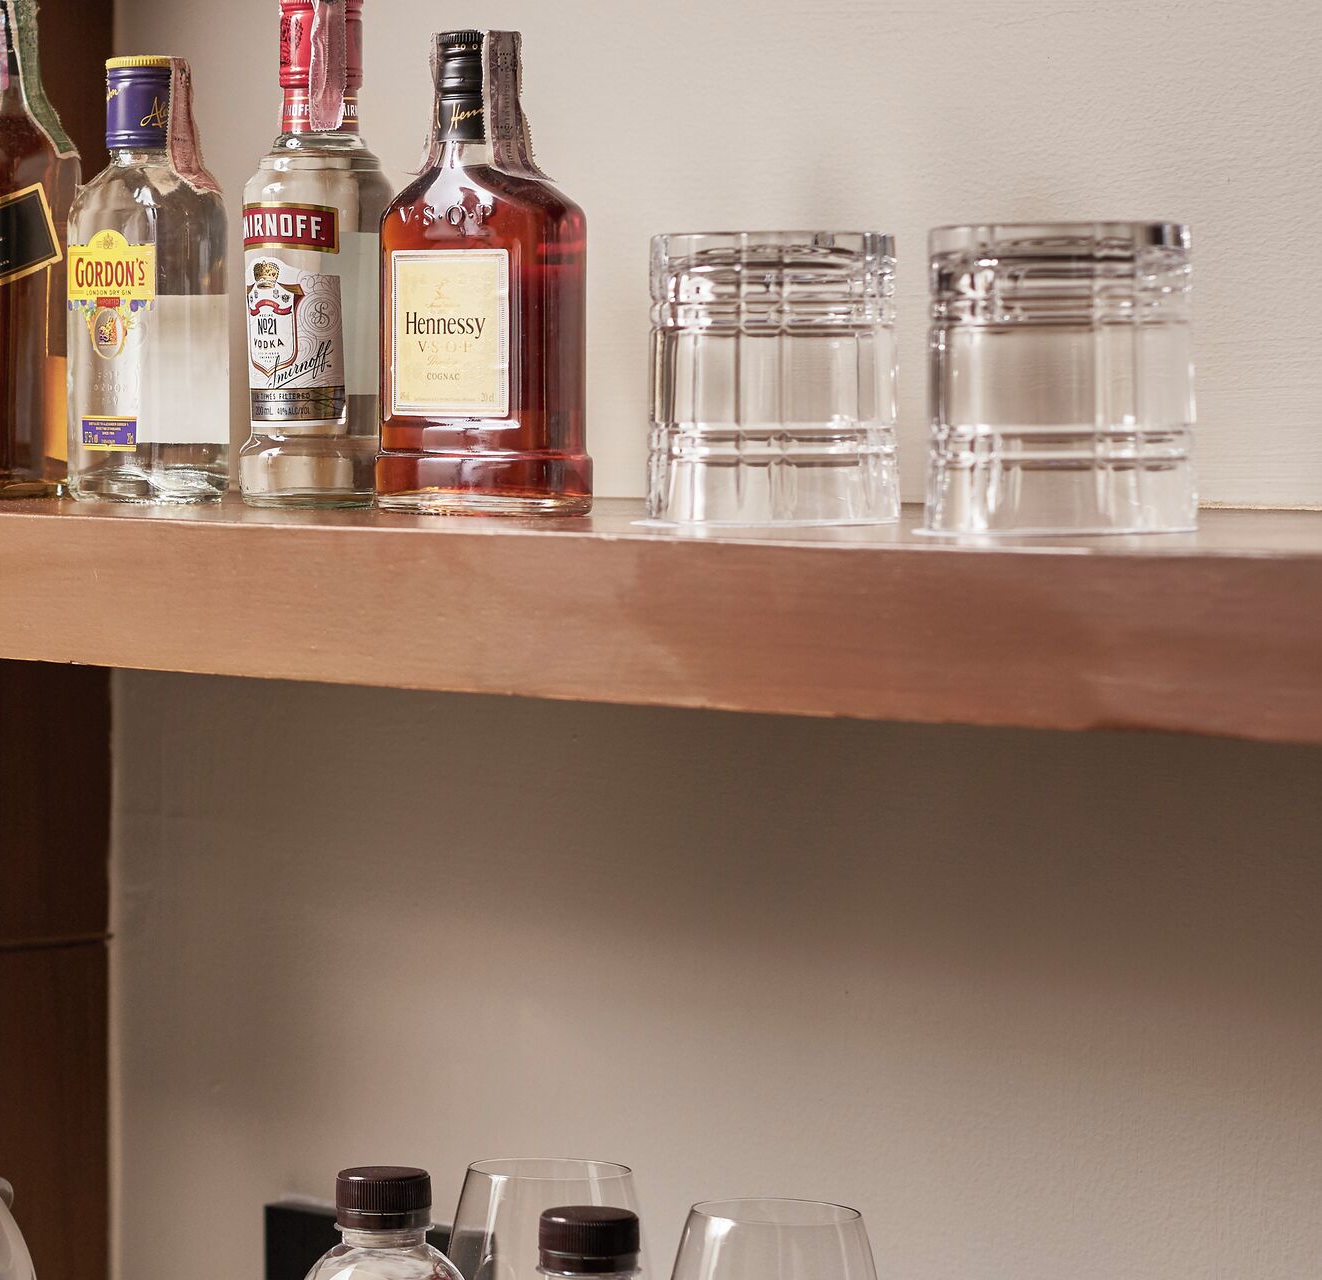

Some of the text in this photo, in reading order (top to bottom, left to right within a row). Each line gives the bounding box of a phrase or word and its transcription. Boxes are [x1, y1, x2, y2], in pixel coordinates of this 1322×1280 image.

[75, 257, 145, 288] GORDON'S
[406, 311, 486, 339] Hennessy
[253, 337, 285, 349] VODKA
[426, 372, 460, 381] COGNAC
